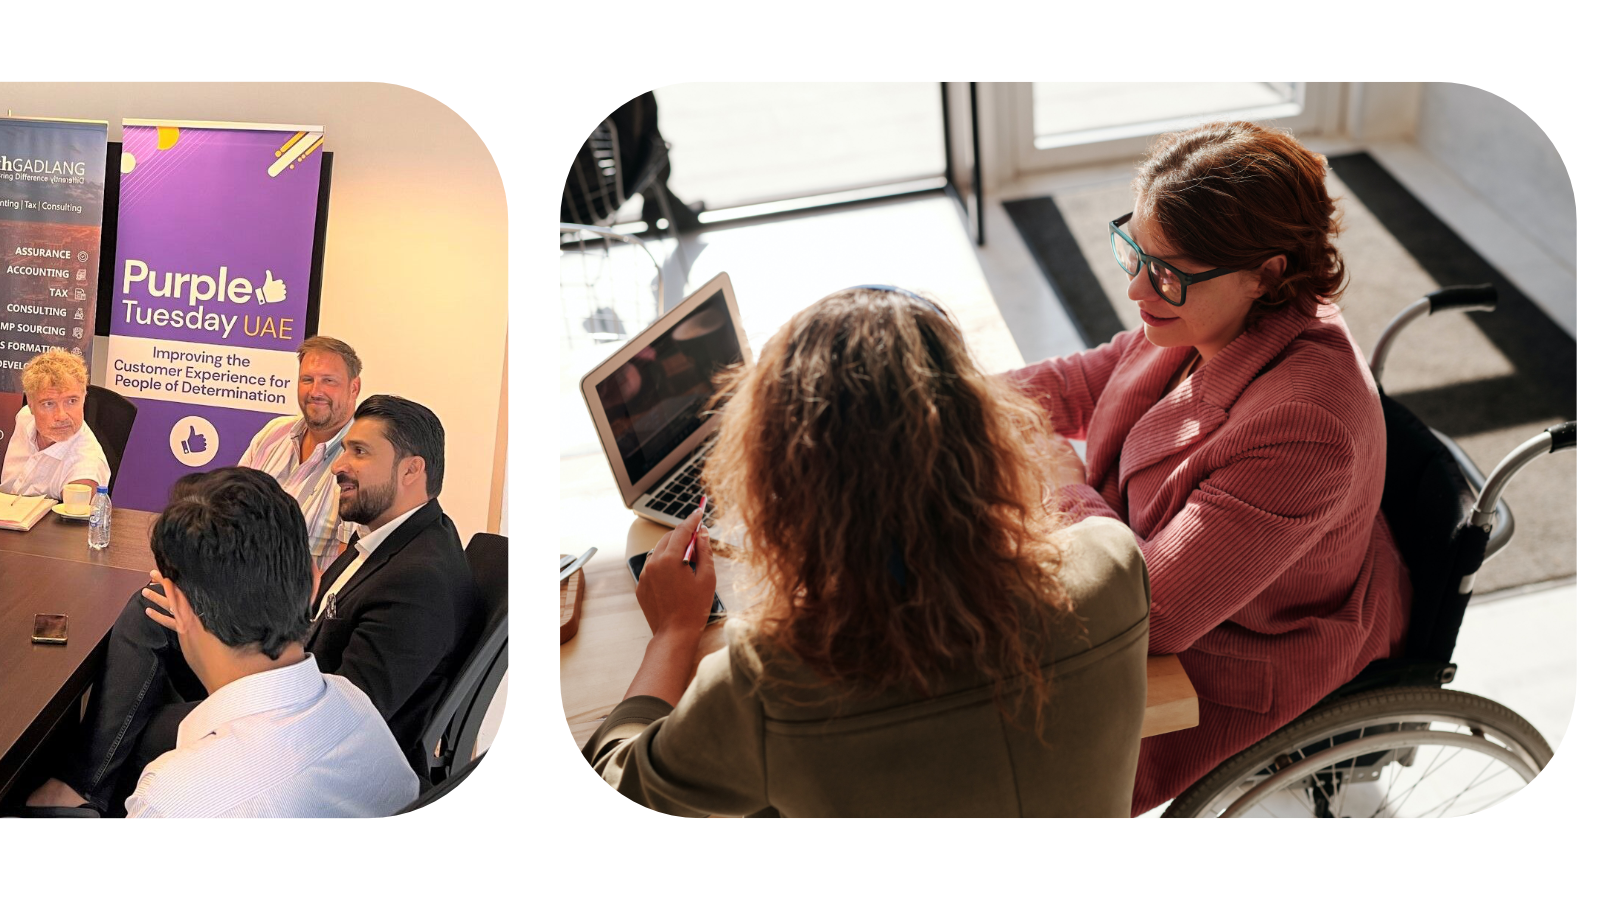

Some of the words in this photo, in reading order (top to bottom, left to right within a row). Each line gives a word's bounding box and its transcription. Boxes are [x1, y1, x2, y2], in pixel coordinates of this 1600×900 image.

[15, 173, 49, 182] Difference
[24, 200, 37, 209] Tax
[42, 202, 82, 213] Consulting
[15, 247, 71, 259] ASSURANCE
[7, 266, 70, 279] ACCOUNTING
[122, 259, 253, 306] Purple
[50, 288, 68, 297] TAX
[7, 304, 67, 317] CONSULTING
[122, 300, 238, 339] Tuesday
[243, 314, 294, 340] UAE
[17, 323, 66, 336] SOURCING
[153, 346, 223, 368] Improving
[226, 354, 251, 367] the
[114, 359, 183, 377] Customer
[185, 366, 267, 386] Experience
[269, 374, 291, 389] for
[115, 374, 162, 392] People
[165, 380, 179, 391] of
[181, 381, 286, 404] Determination
